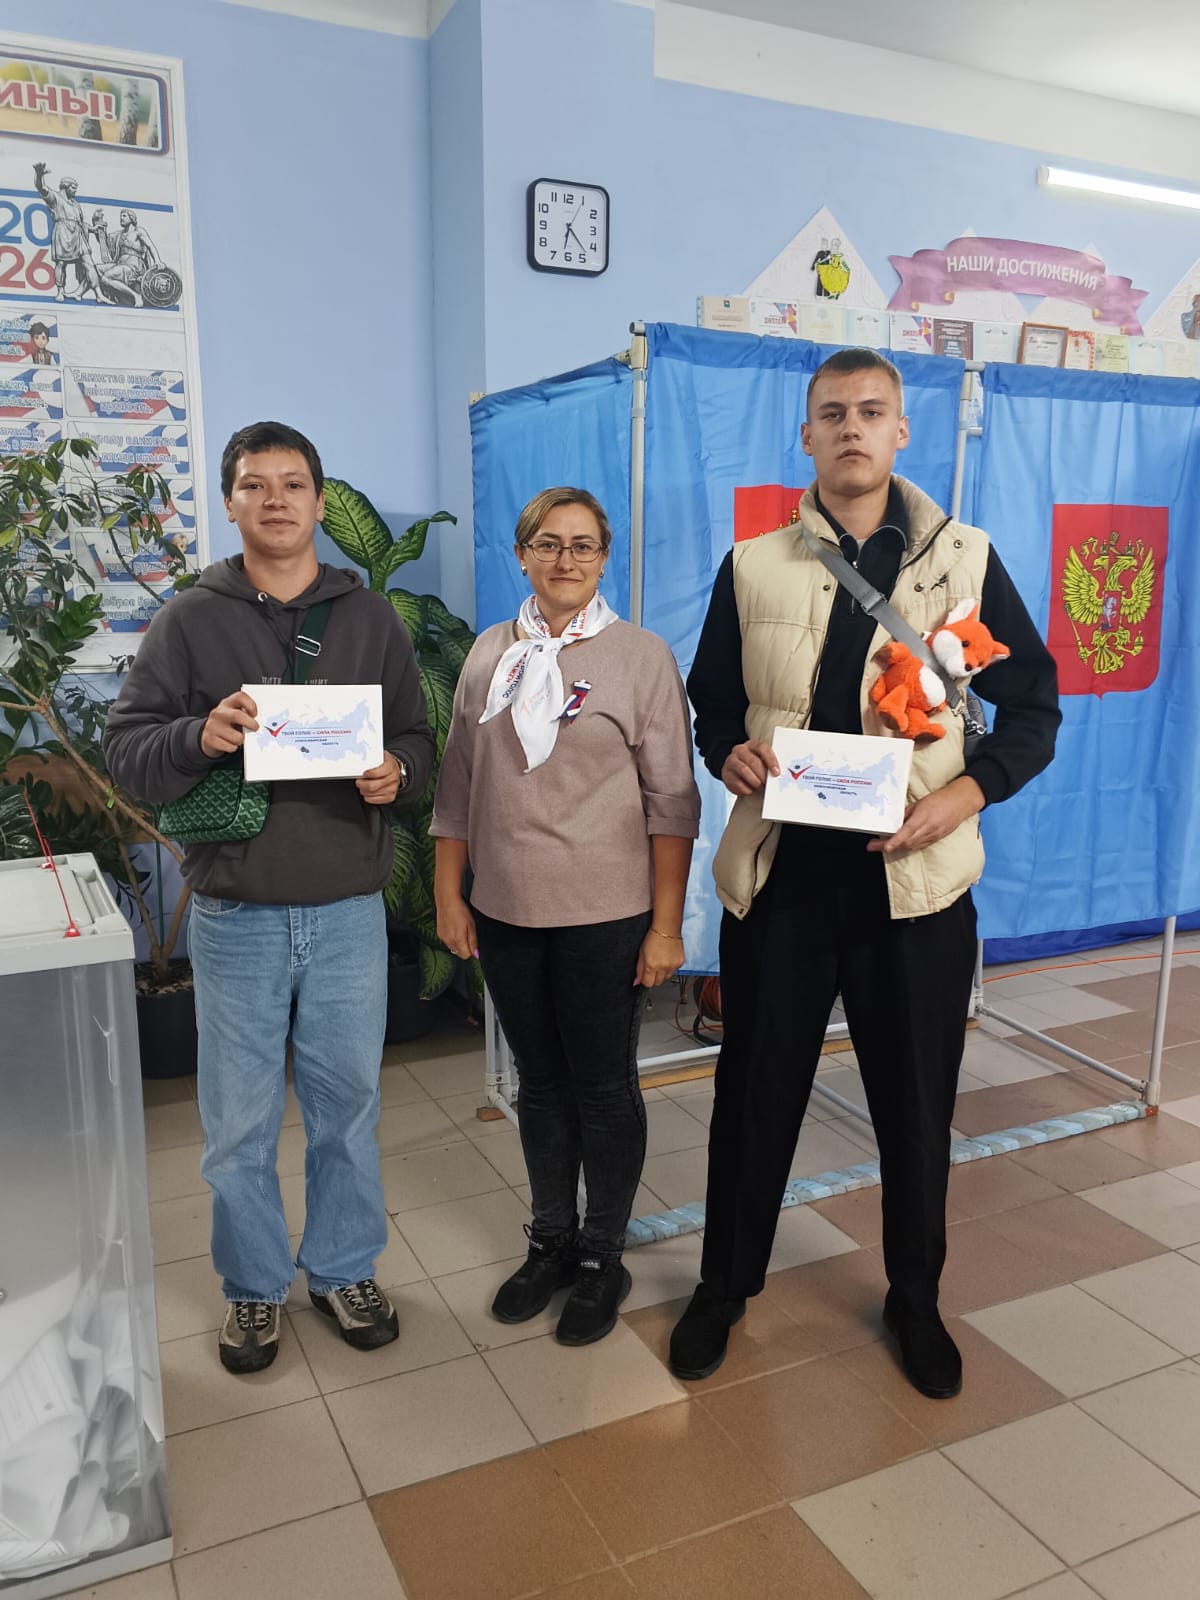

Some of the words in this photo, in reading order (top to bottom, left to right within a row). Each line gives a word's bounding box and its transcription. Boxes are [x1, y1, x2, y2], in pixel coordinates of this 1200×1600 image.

[551, 191, 557, 203] 11
[563, 193, 574, 204] 12
[581, 195, 585, 206] 1
[538, 202, 549, 214] 10
[589, 209, 598, 220] 2
[539, 220, 547, 230] 9
[589, 225, 597, 236] 3
[539, 236, 548, 247] 8
[589, 242, 597, 253] 4
[550, 250, 557, 260] 7
[564, 251, 573, 262] 6
[578, 253, 587, 263] 5
[946, 255, 994, 273] НАШИ
[996, 257, 1099, 291] ДОСТИЖЕНИЯ
